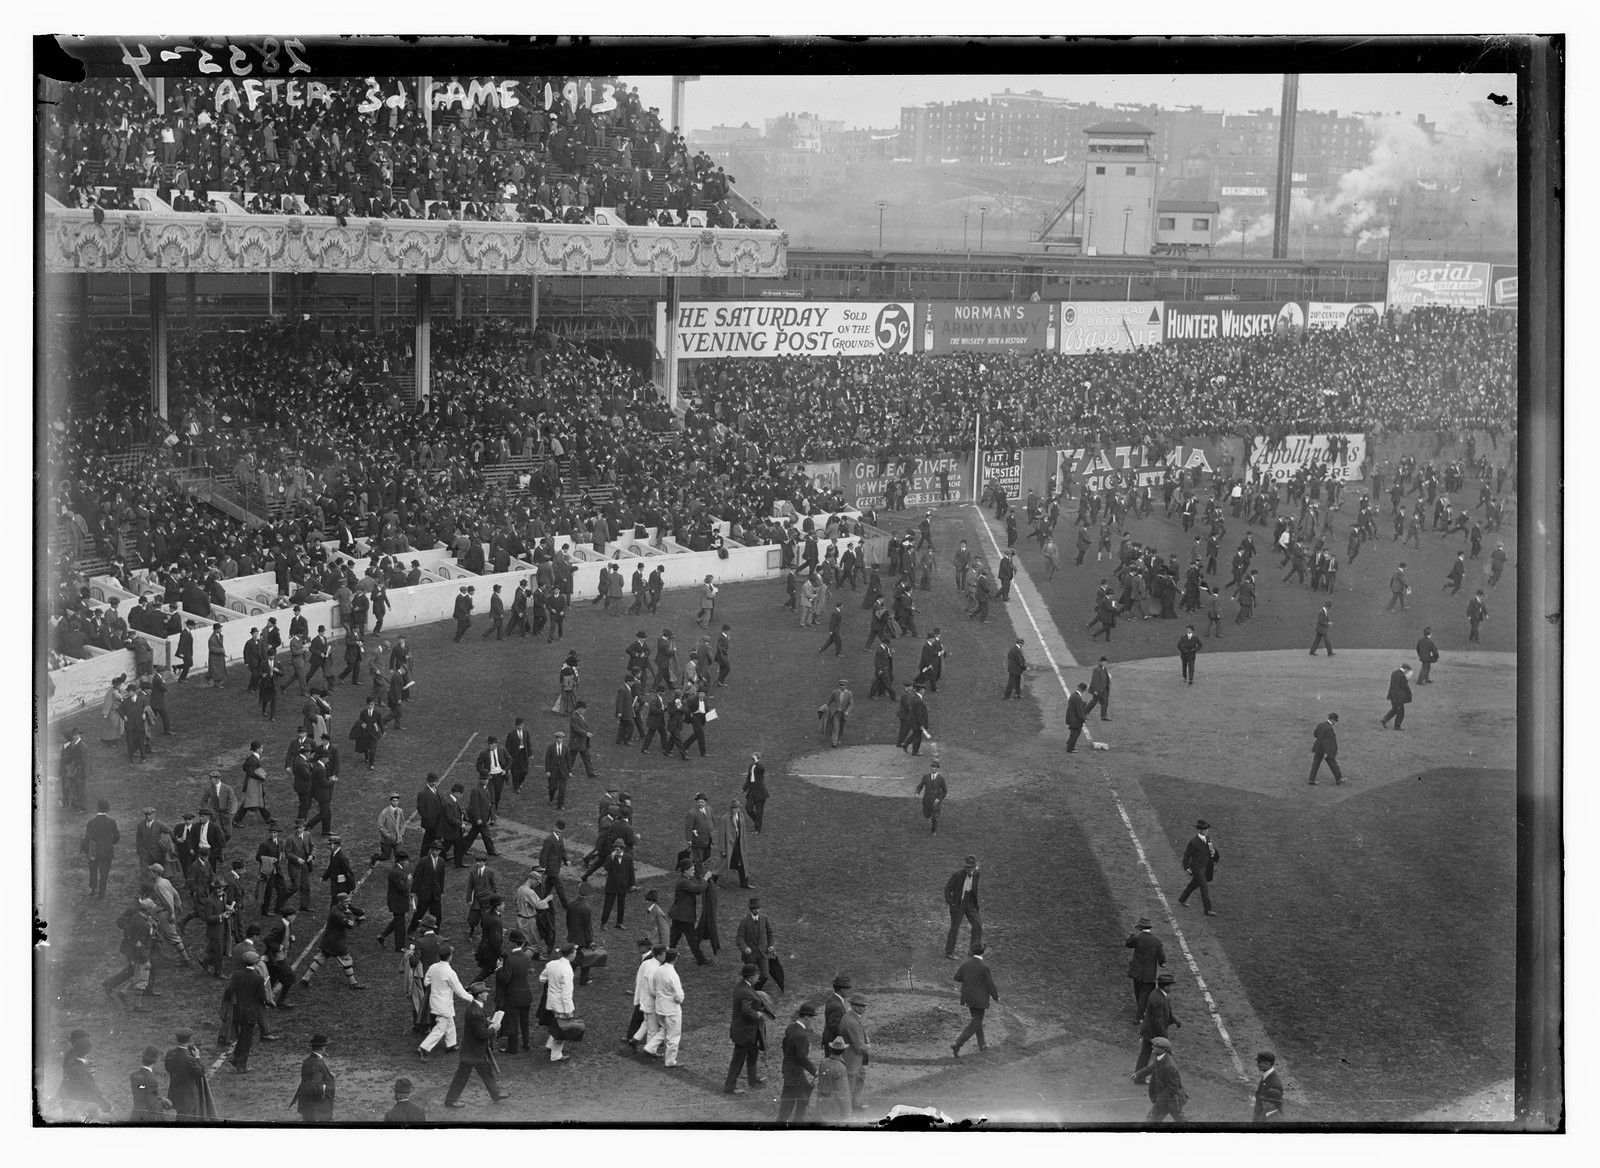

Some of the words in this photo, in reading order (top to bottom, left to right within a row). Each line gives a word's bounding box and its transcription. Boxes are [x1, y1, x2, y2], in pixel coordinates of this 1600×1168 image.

[843, 309, 867, 321] SOLD
[955, 306, 1025, 320] NORMAN'S
[1083, 306, 1112, 315] DOGS
[1117, 305, 1145, 315] HEAD
[677, 307, 708, 328] HE
[714, 307, 829, 331] SATURDAY
[941, 320, 982, 336] ARMY
[986, 321, 998, 334] &
[1004, 318, 1042, 334] NAVY
[1167, 309, 1218, 339] HUNTER
[1221, 309, 1277, 338] WHISKEY
[838, 325, 851, 334] ON
[853, 325, 870, 334] THE
[678, 332, 767, 352] VENING
[773, 331, 833, 351] POST
[832, 337, 875, 350] GROUNDS
[1257, 437, 1359, 469] Apollinas
[985, 465, 1020, 479] WEBSTER
[867, 476, 933, 494] WHEY
